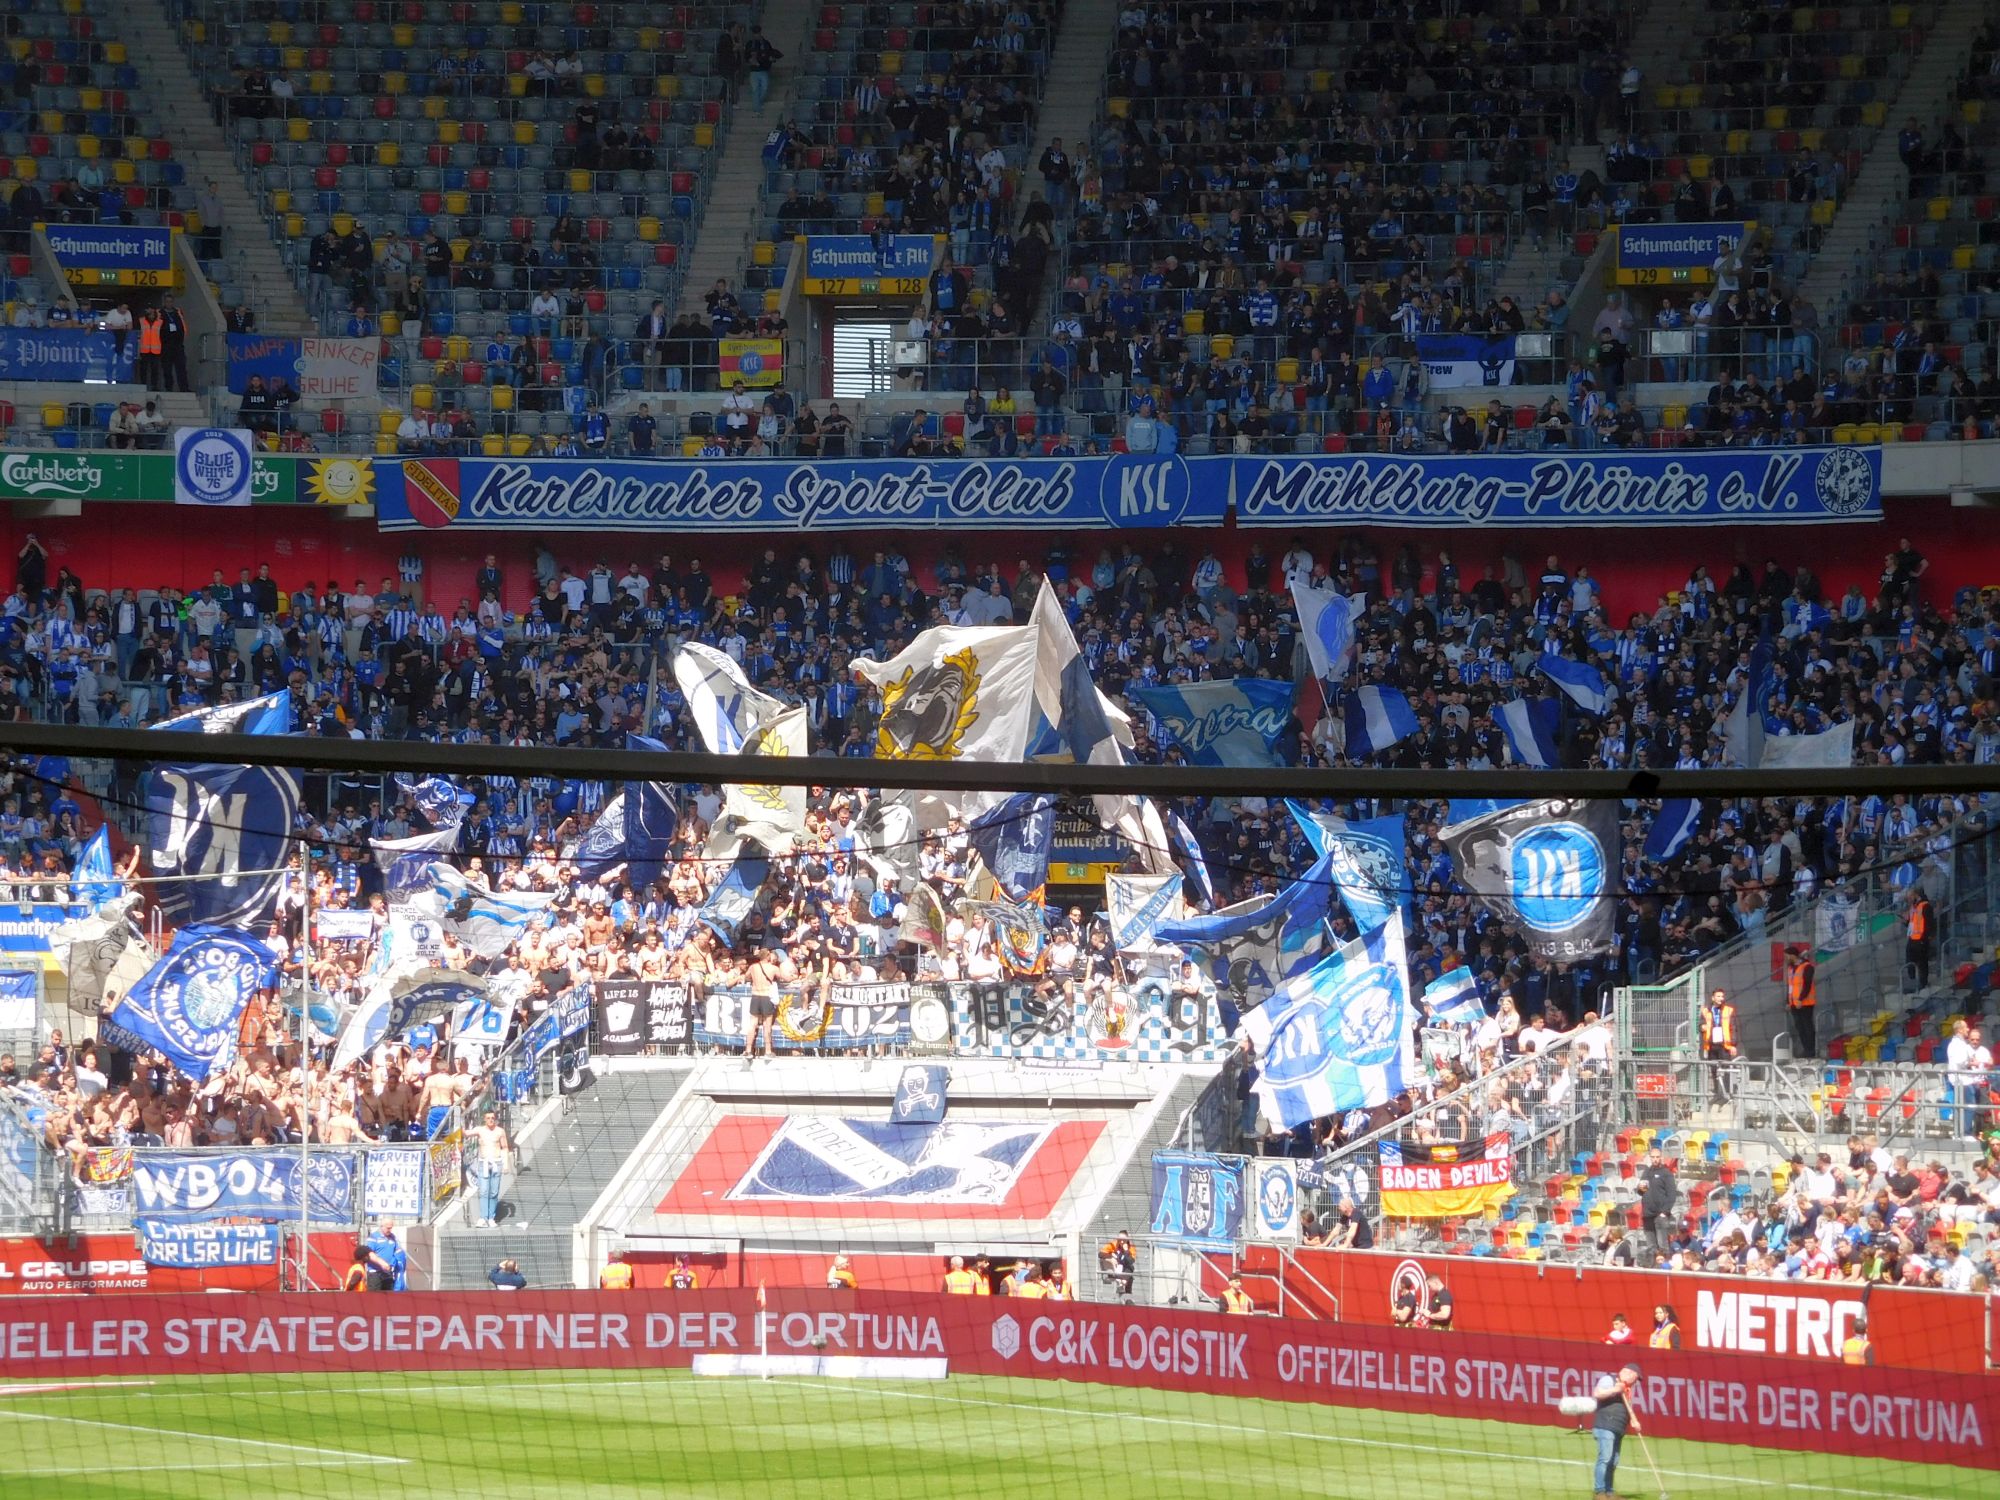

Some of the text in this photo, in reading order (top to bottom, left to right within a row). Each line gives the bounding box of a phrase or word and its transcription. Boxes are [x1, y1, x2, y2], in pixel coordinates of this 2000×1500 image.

[51, 237, 166, 257] Schumacher Alt
[1623, 235, 1713, 256] Schumacher
[907, 248, 928, 266] Alt
[66, 268, 84, 284] 25
[132, 271, 158, 286] 126
[895, 278, 921, 293] 128
[1632, 268, 1658, 284] 129
[819, 279, 846, 293] 127
[16, 338, 96, 367] Phönix
[194, 449, 234, 467] BLUE
[1, 454, 103, 490] Carlsberg
[194, 463, 234, 478] WHITE
[206, 478, 221, 489] 76
[405, 462, 458, 513] FIDELITAS
[1119, 460, 1173, 517] KSC
[1246, 453, 1803, 525] Mühlburg-Phönix e.V.
[470, 460, 1076, 528] Karlsruher Sport-Club
[604, 989, 639, 1000] LIFE IS
[457, 996, 503, 1034] 76
[609, 1032, 641, 1043] GAMBLE
[369, 1150, 420, 1163] NERVEN
[368, 1167, 418, 1178] KLINIK
[1381, 1159, 1509, 1190] BADEN DEVILS
[133, 1158, 285, 1210] WB'04
[366, 1183, 418, 1193] KARLS
[366, 1199, 418, 1209] RUHE
[148, 1220, 266, 1240] CHAOTEN
[142, 1239, 273, 1263] KARLSRUHE
[21, 1260, 148, 1278] GRUPPE
[22, 1279, 148, 1290] AUTO PERFORMANCE
[163, 1312, 630, 1355] STRATEGIEPARTNER
[645, 1311, 738, 1348] DER
[755, 1311, 945, 1353] FORTUNA
[1696, 1289, 1868, 1358] METRO
[1028, 1316, 1249, 1379] C&K LOGISTIK
[1278, 1343, 1448, 1396] OFFIZIELLER
[1757, 1384, 1823, 1432] DER
[1830, 1391, 1984, 1446] FORTUNA
